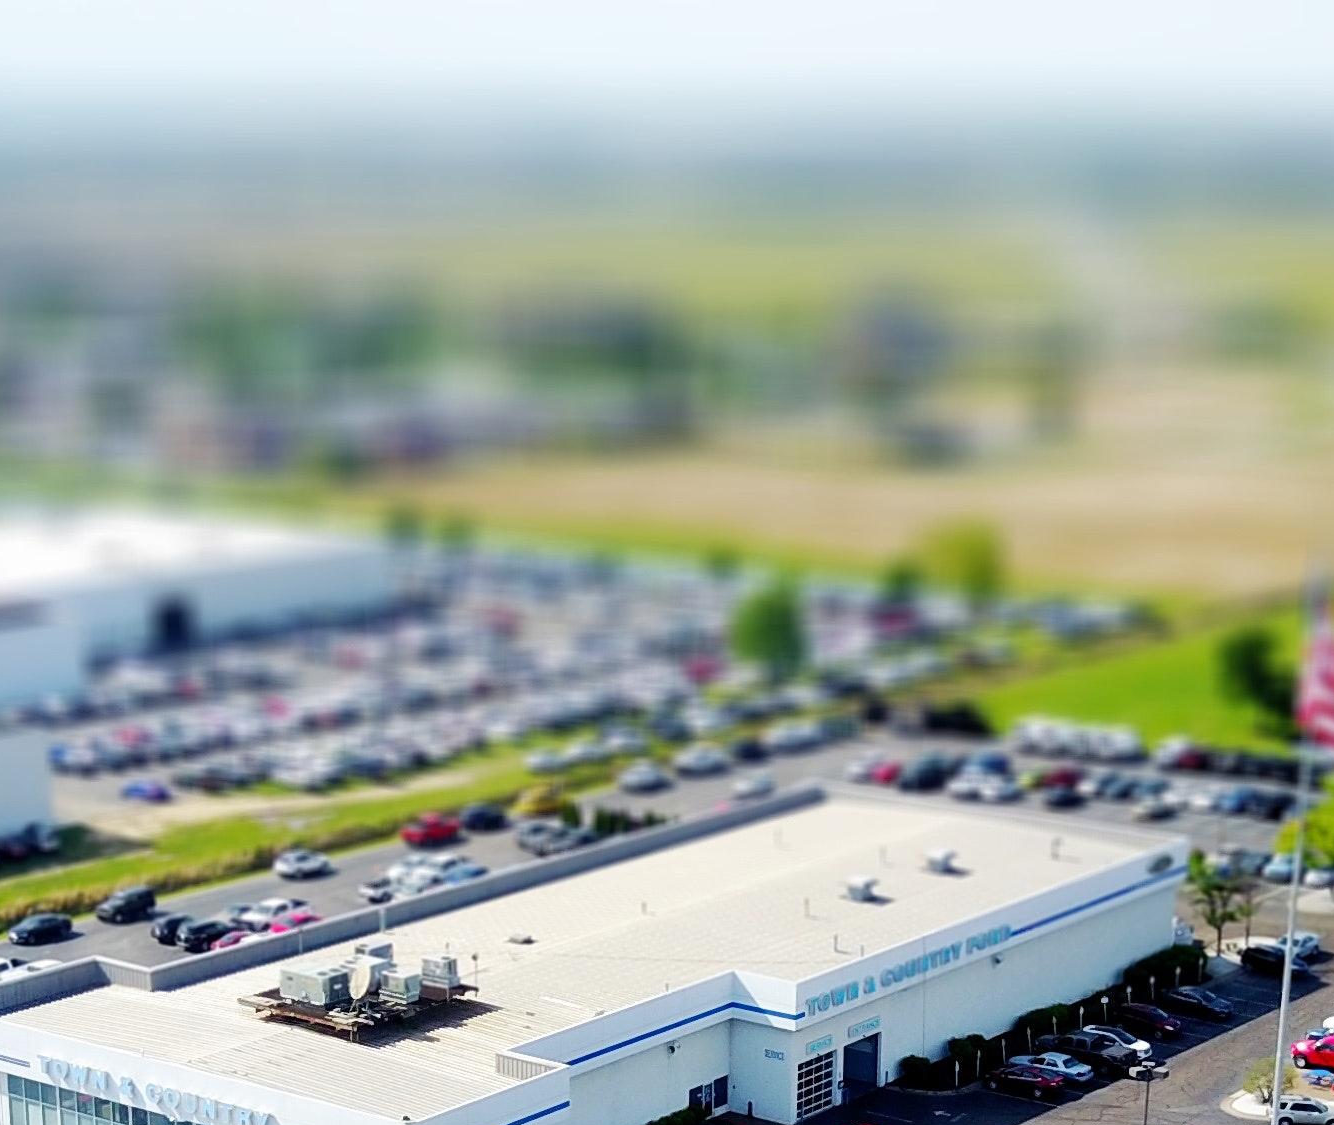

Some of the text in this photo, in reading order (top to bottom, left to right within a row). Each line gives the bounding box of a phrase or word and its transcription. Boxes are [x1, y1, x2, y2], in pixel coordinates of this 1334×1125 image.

[805, 981, 859, 1016] TOWN
[880, 942, 963, 987] COUNTRY
[37, 1054, 109, 1090] TOWN
[120, 1077, 133, 1097] &
